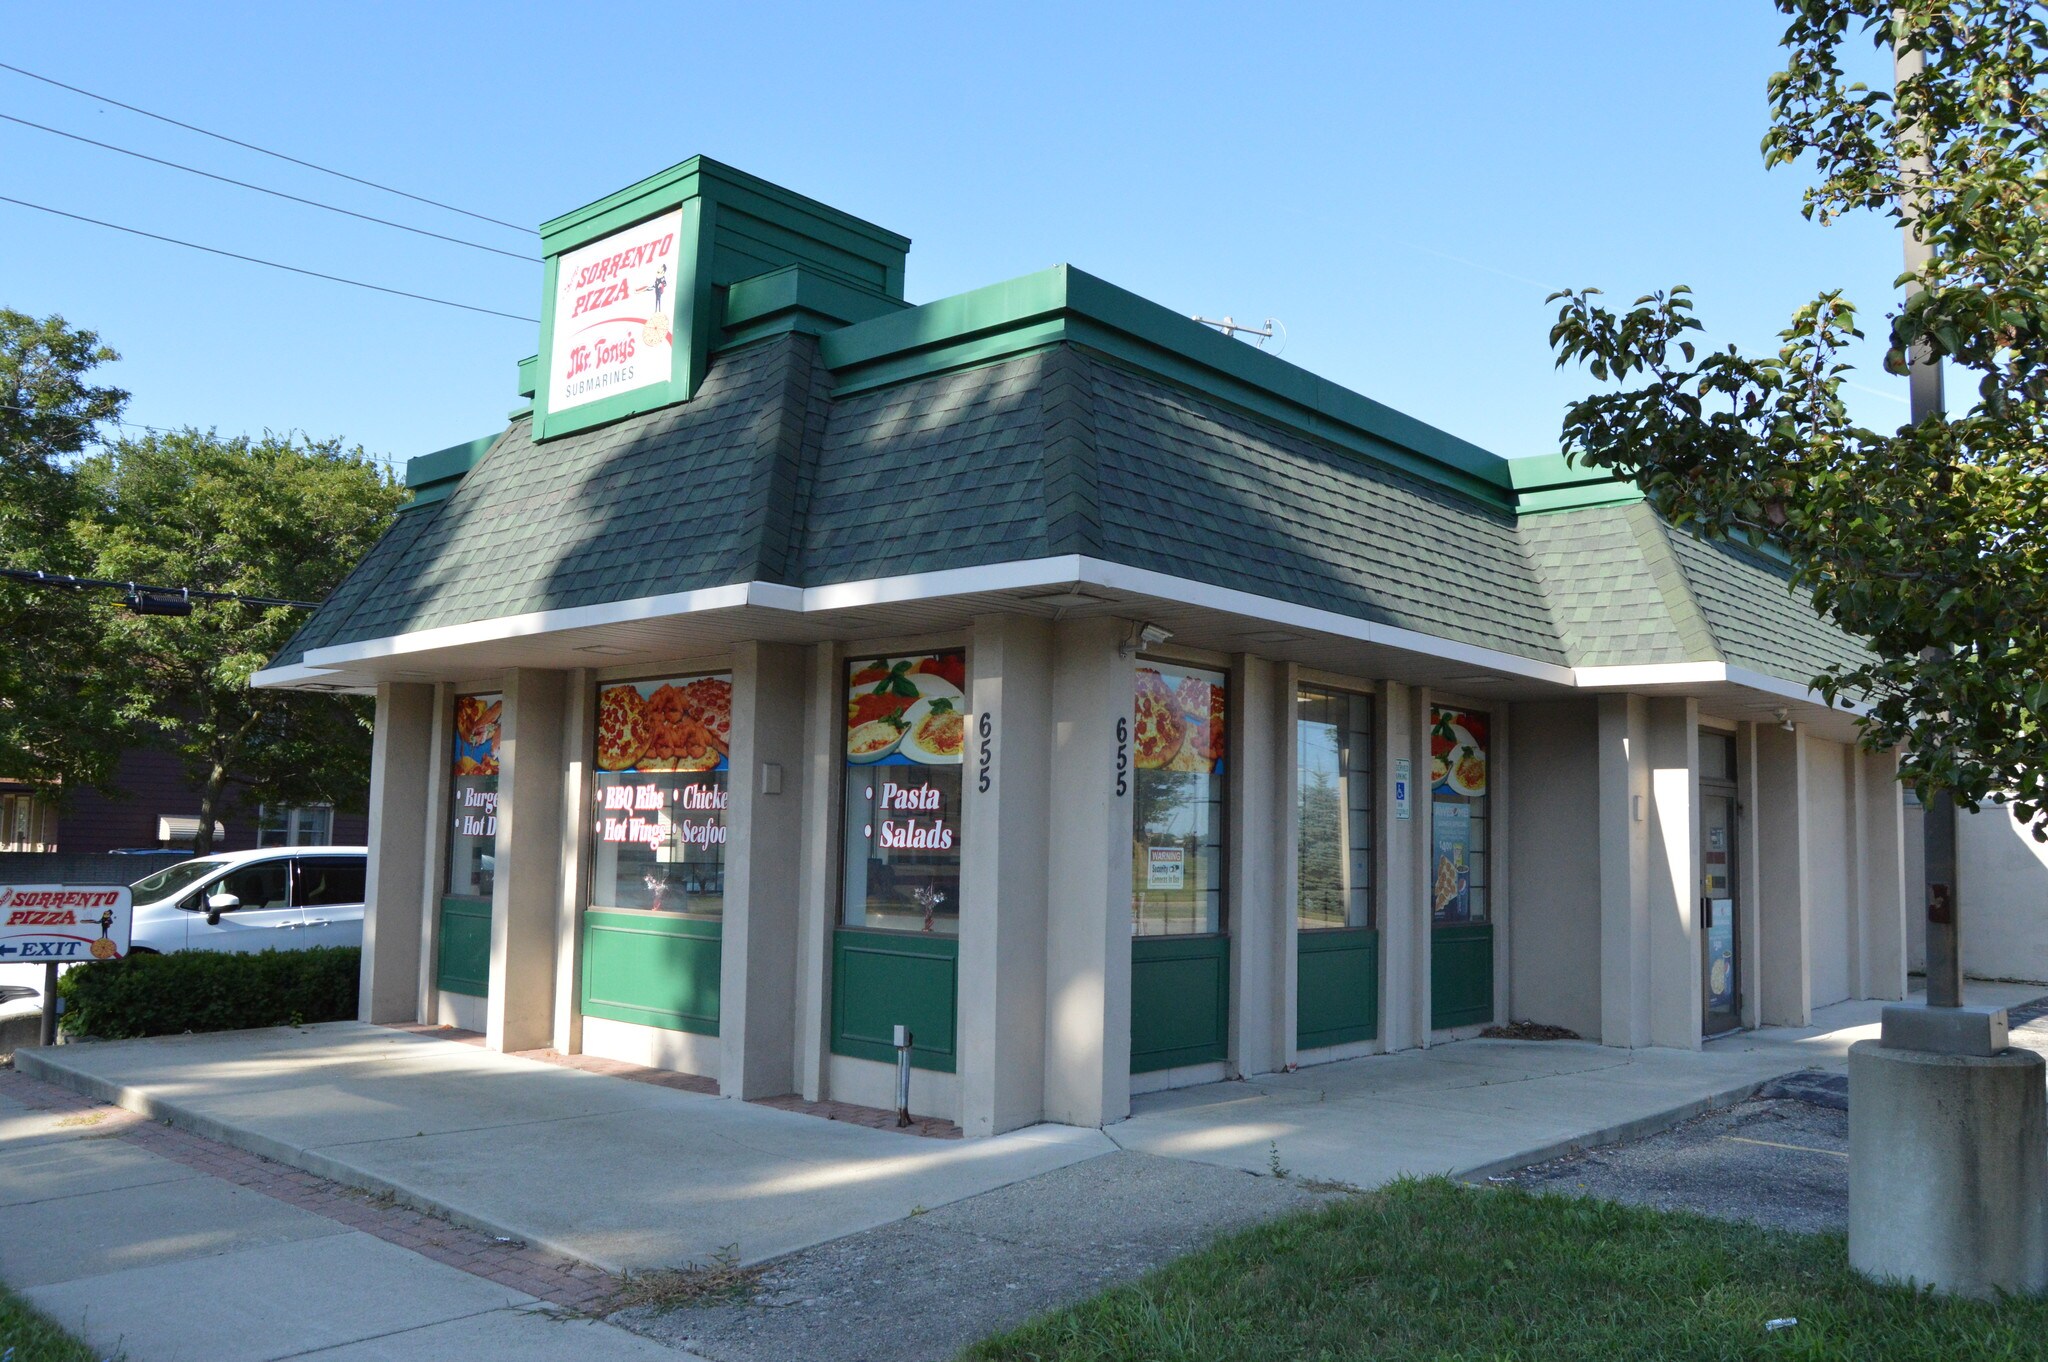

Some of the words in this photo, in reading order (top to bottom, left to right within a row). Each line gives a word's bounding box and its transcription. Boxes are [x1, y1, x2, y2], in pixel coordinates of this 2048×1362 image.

[576, 233, 674, 289] SORRENTO
[572, 278, 630, 318] PIZZA
[567, 344, 592, 380] Mr.
[595, 331, 636, 369] Tony's
[566, 366, 634, 398] SUBMARINES
[605, 784, 634, 817] BBQ
[634, 783, 665, 810] Ribs
[880, 782, 940, 810] Pasta
[462, 815, 485, 836] Hot
[604, 817, 628, 842] Hot
[629, 816, 666, 851] Wings
[880, 819, 953, 850] Salads
[1152, 851, 1181, 861] WARNING
[9, 891, 120, 908] SORRENTO
[6, 910, 77, 926] PIZZA
[19, 941, 82, 957] EXIT
